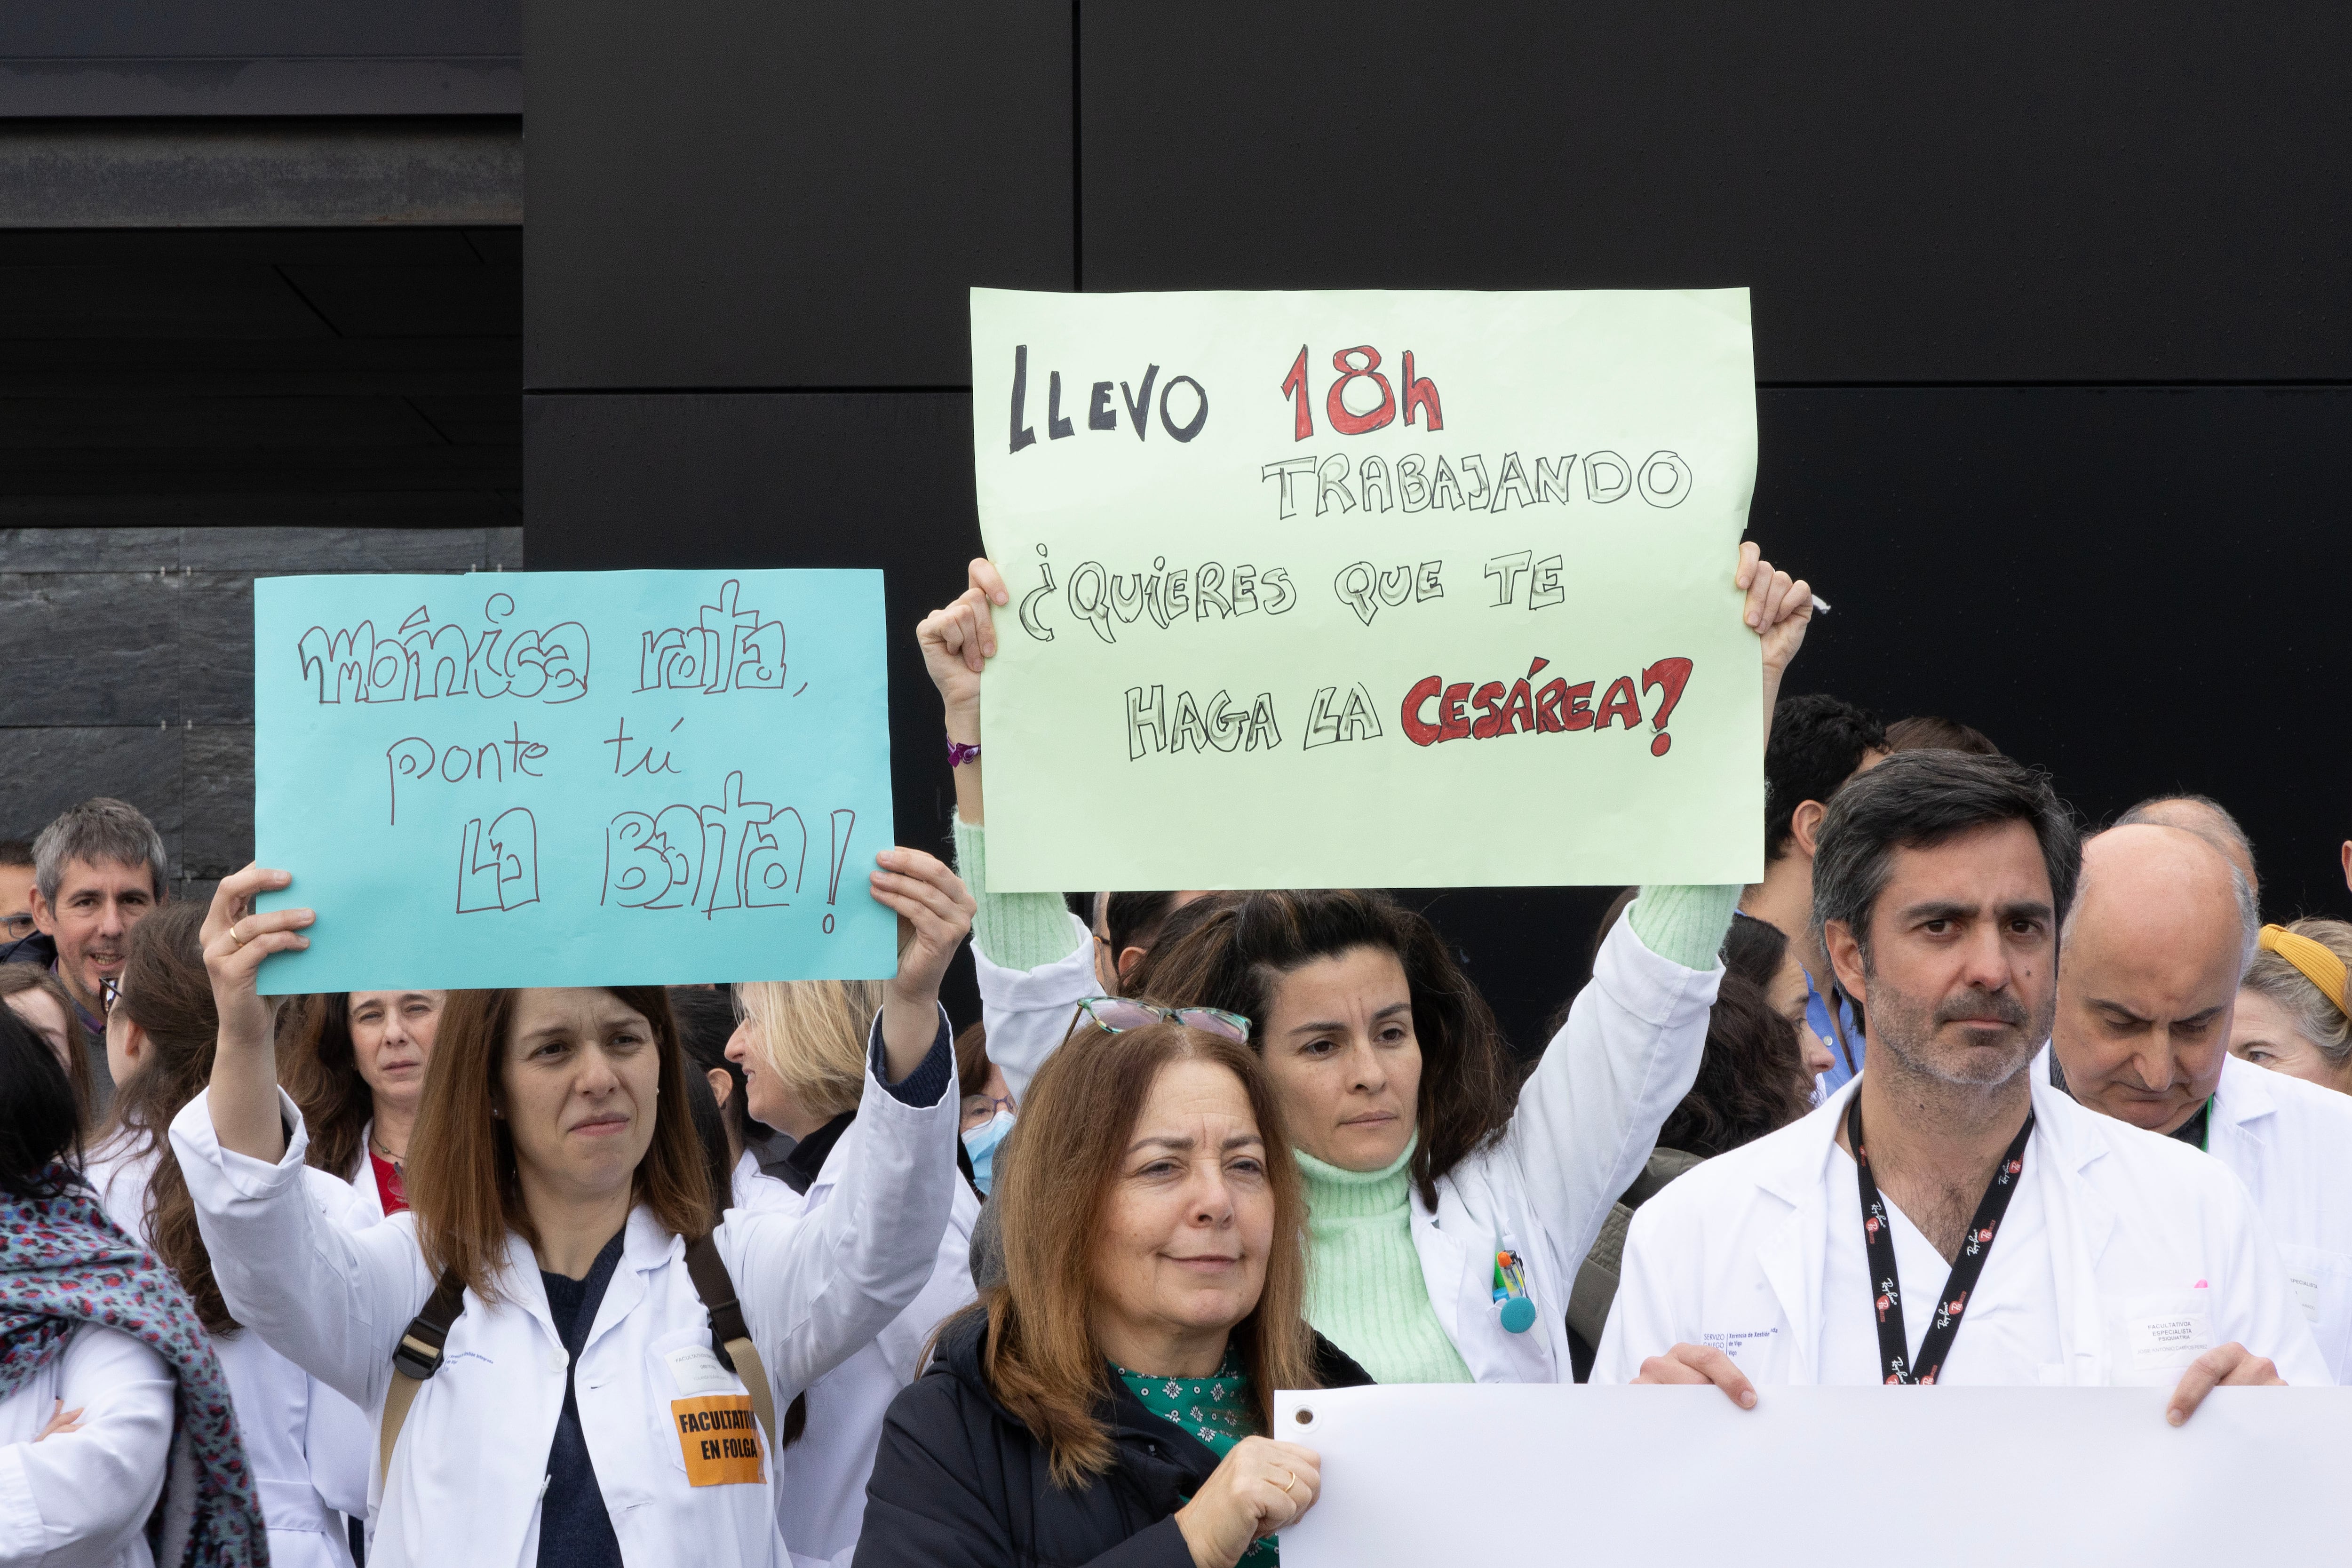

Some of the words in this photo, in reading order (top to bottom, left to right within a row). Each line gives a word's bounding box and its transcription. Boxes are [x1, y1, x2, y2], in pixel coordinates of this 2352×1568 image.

[1009, 344, 1209, 455] LLEVO
[1279, 343, 1445, 443] 18h
[1261, 450, 1693, 521] TRABAJANDO
[1334, 559, 1445, 628] QUE
[1484, 549, 1565, 612] TE
[1123, 684, 1283, 763] HAGA
[1303, 681, 1383, 752] LA
[1400, 655, 1694, 758] CESÁREA?
[386, 720, 549, 827] ponte
[603, 716, 685, 778] tú
[701, 1439, 721, 1460] EN
[722, 1437, 758, 1458] FOLGA
